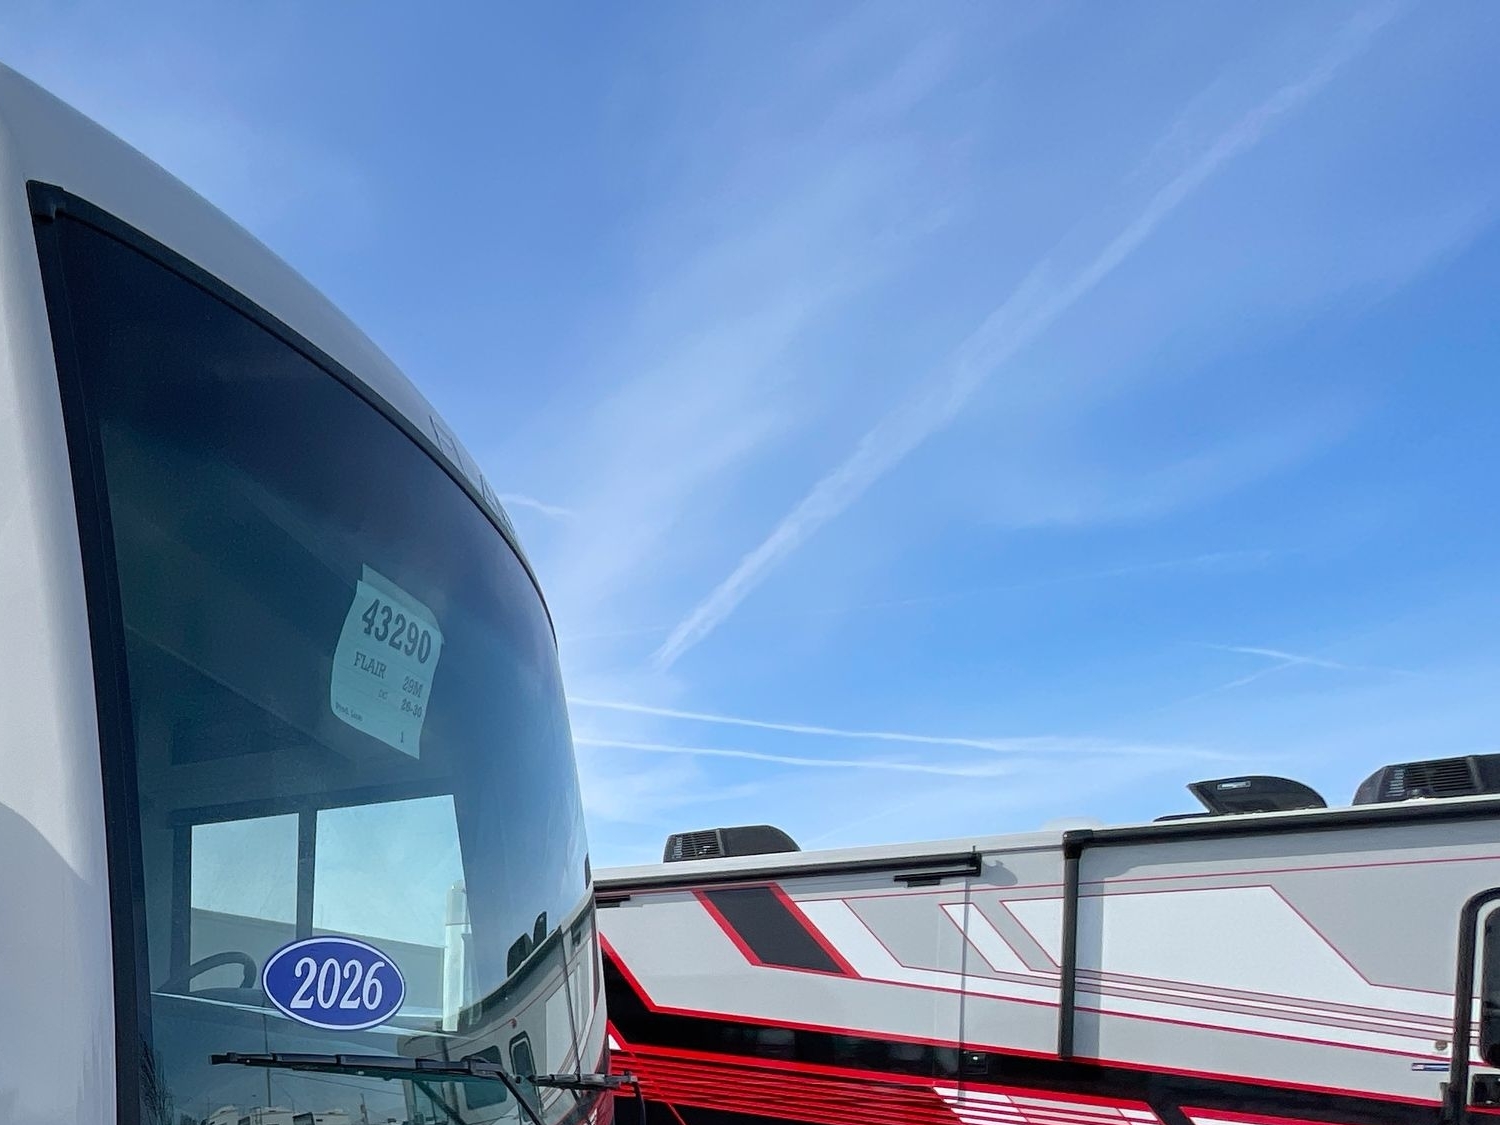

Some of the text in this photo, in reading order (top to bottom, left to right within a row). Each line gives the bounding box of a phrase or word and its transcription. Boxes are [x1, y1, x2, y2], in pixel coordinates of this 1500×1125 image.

[362, 598, 431, 664] 43290
[353, 651, 387, 679] FLAIR
[402, 676, 423, 698] 29M
[290, 957, 386, 1010] 2026
